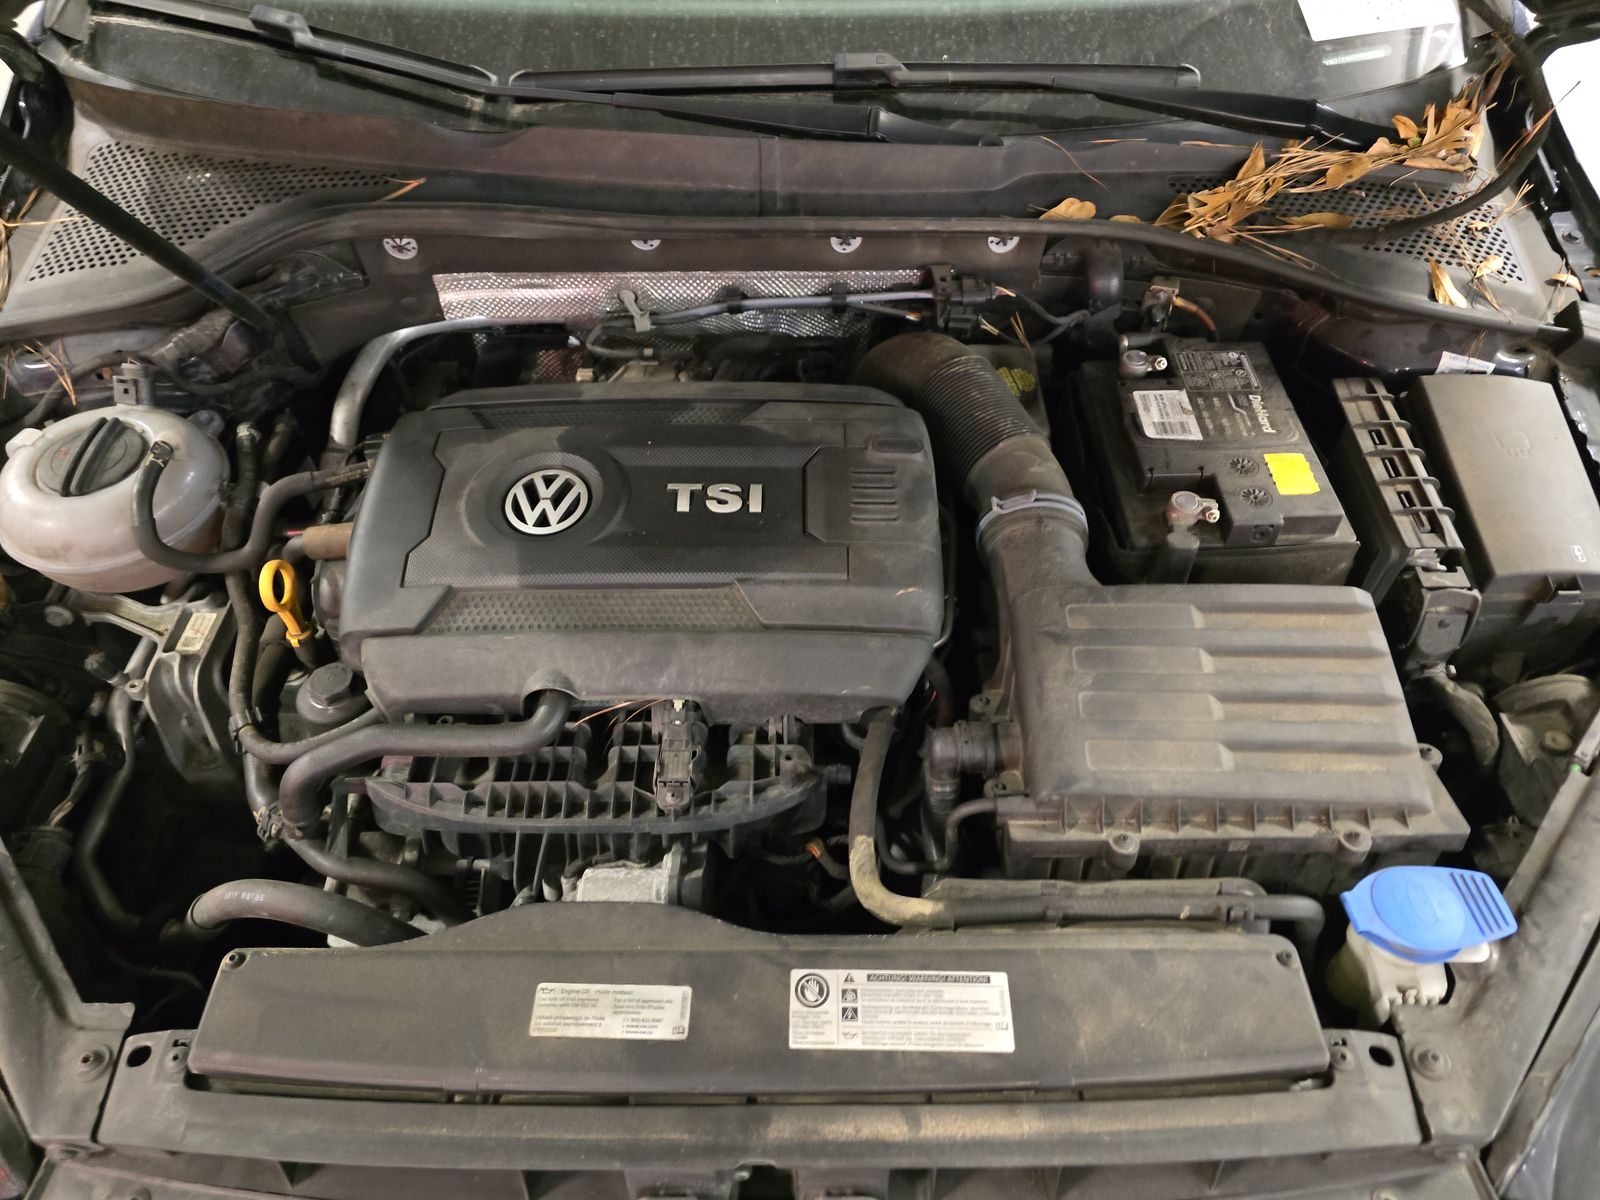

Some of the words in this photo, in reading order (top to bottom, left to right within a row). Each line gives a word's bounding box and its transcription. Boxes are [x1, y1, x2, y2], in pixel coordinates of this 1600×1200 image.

[1248, 394, 1277, 434] DieHard
[505, 469, 589, 535] VW
[666, 482, 764, 514] TSI
